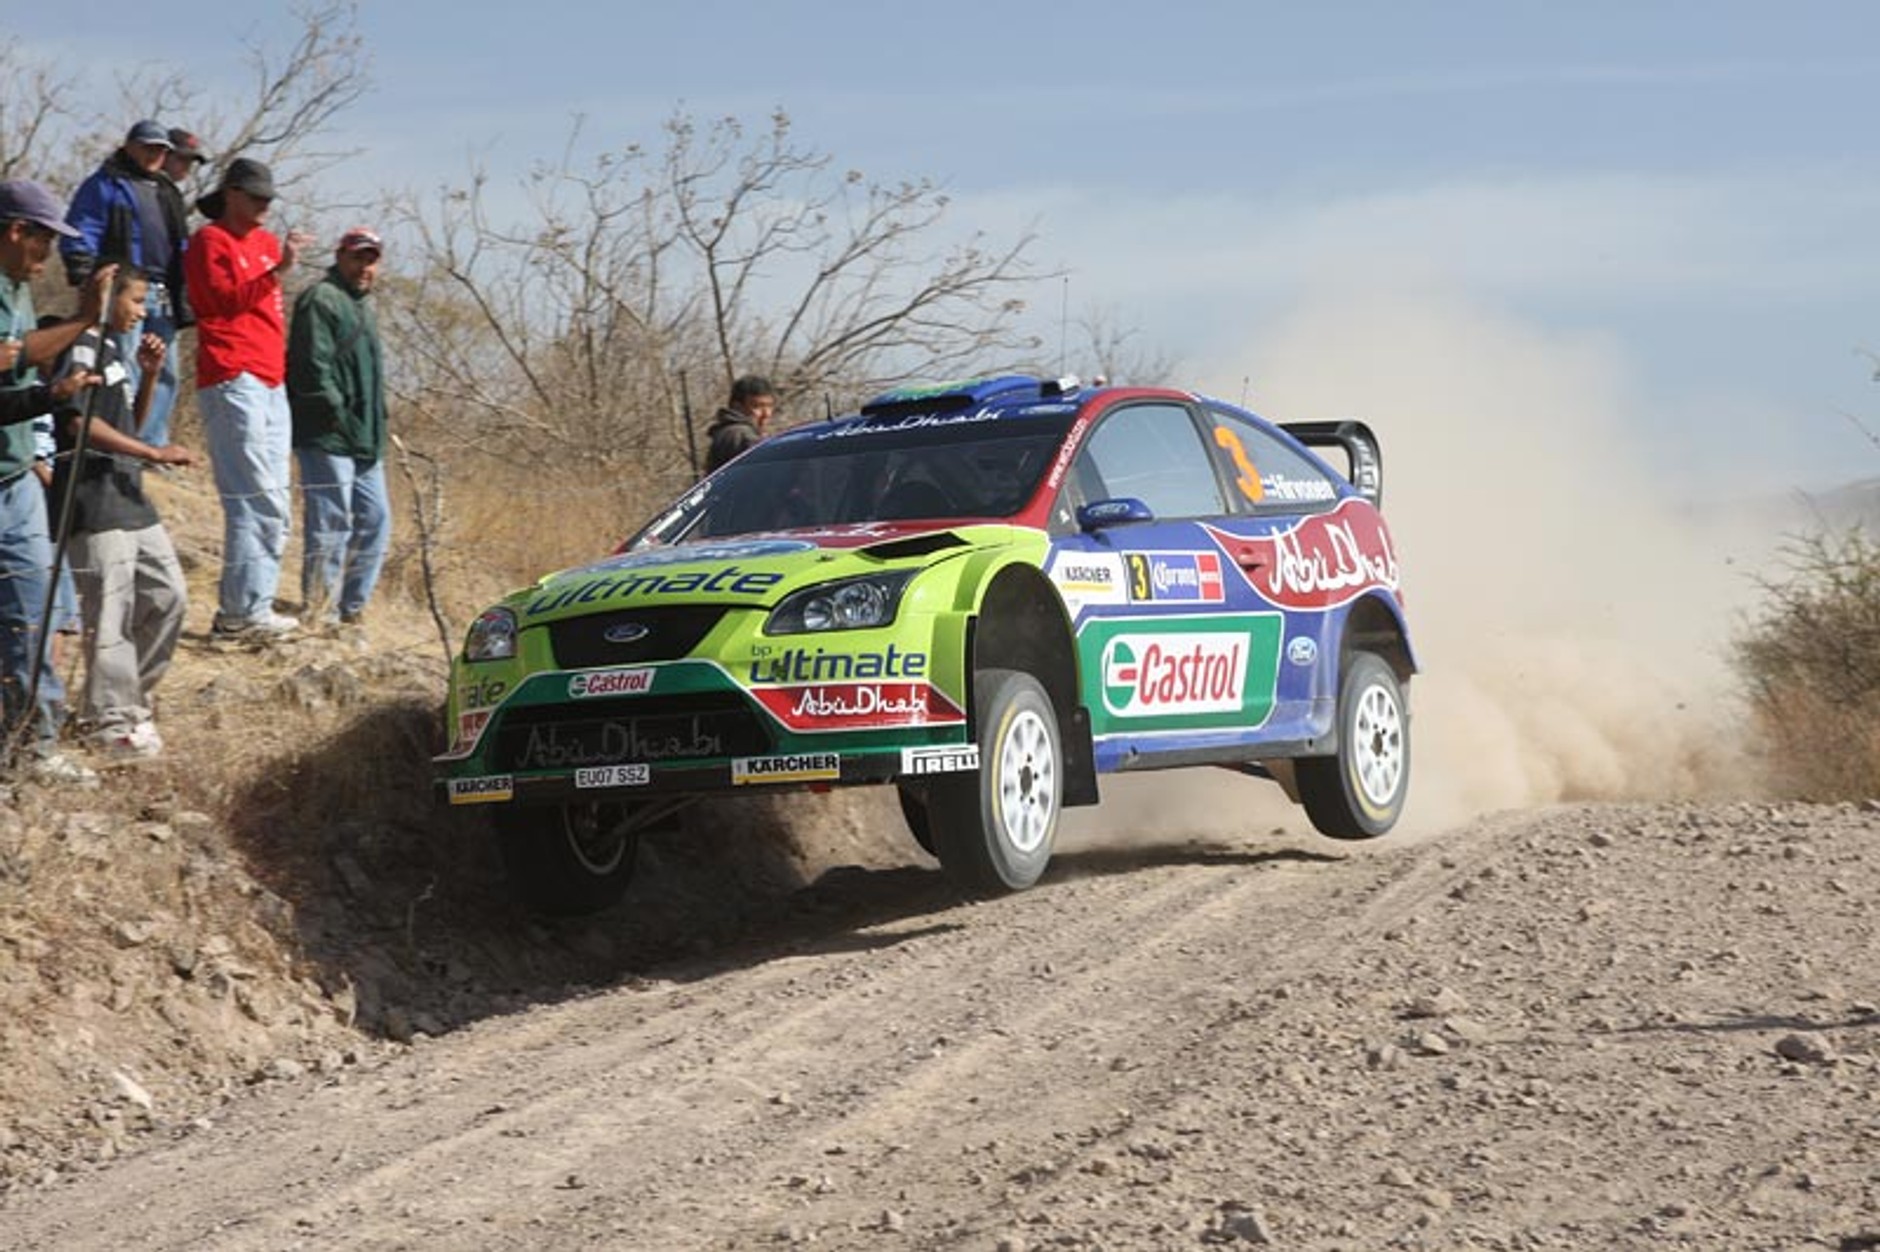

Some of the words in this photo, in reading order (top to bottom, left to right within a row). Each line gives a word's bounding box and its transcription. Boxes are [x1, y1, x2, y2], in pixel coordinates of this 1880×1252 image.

[1213, 425, 1263, 505] 3
[1131, 555, 1147, 599] 3
[1323, 519, 1400, 590] Dhab
[527, 566, 784, 617] ultimate
[588, 671, 649, 694] Castrol
[751, 645, 926, 683] ultimate
[1139, 643, 1239, 706] Castrol
[579, 767, 613, 786] EU07
